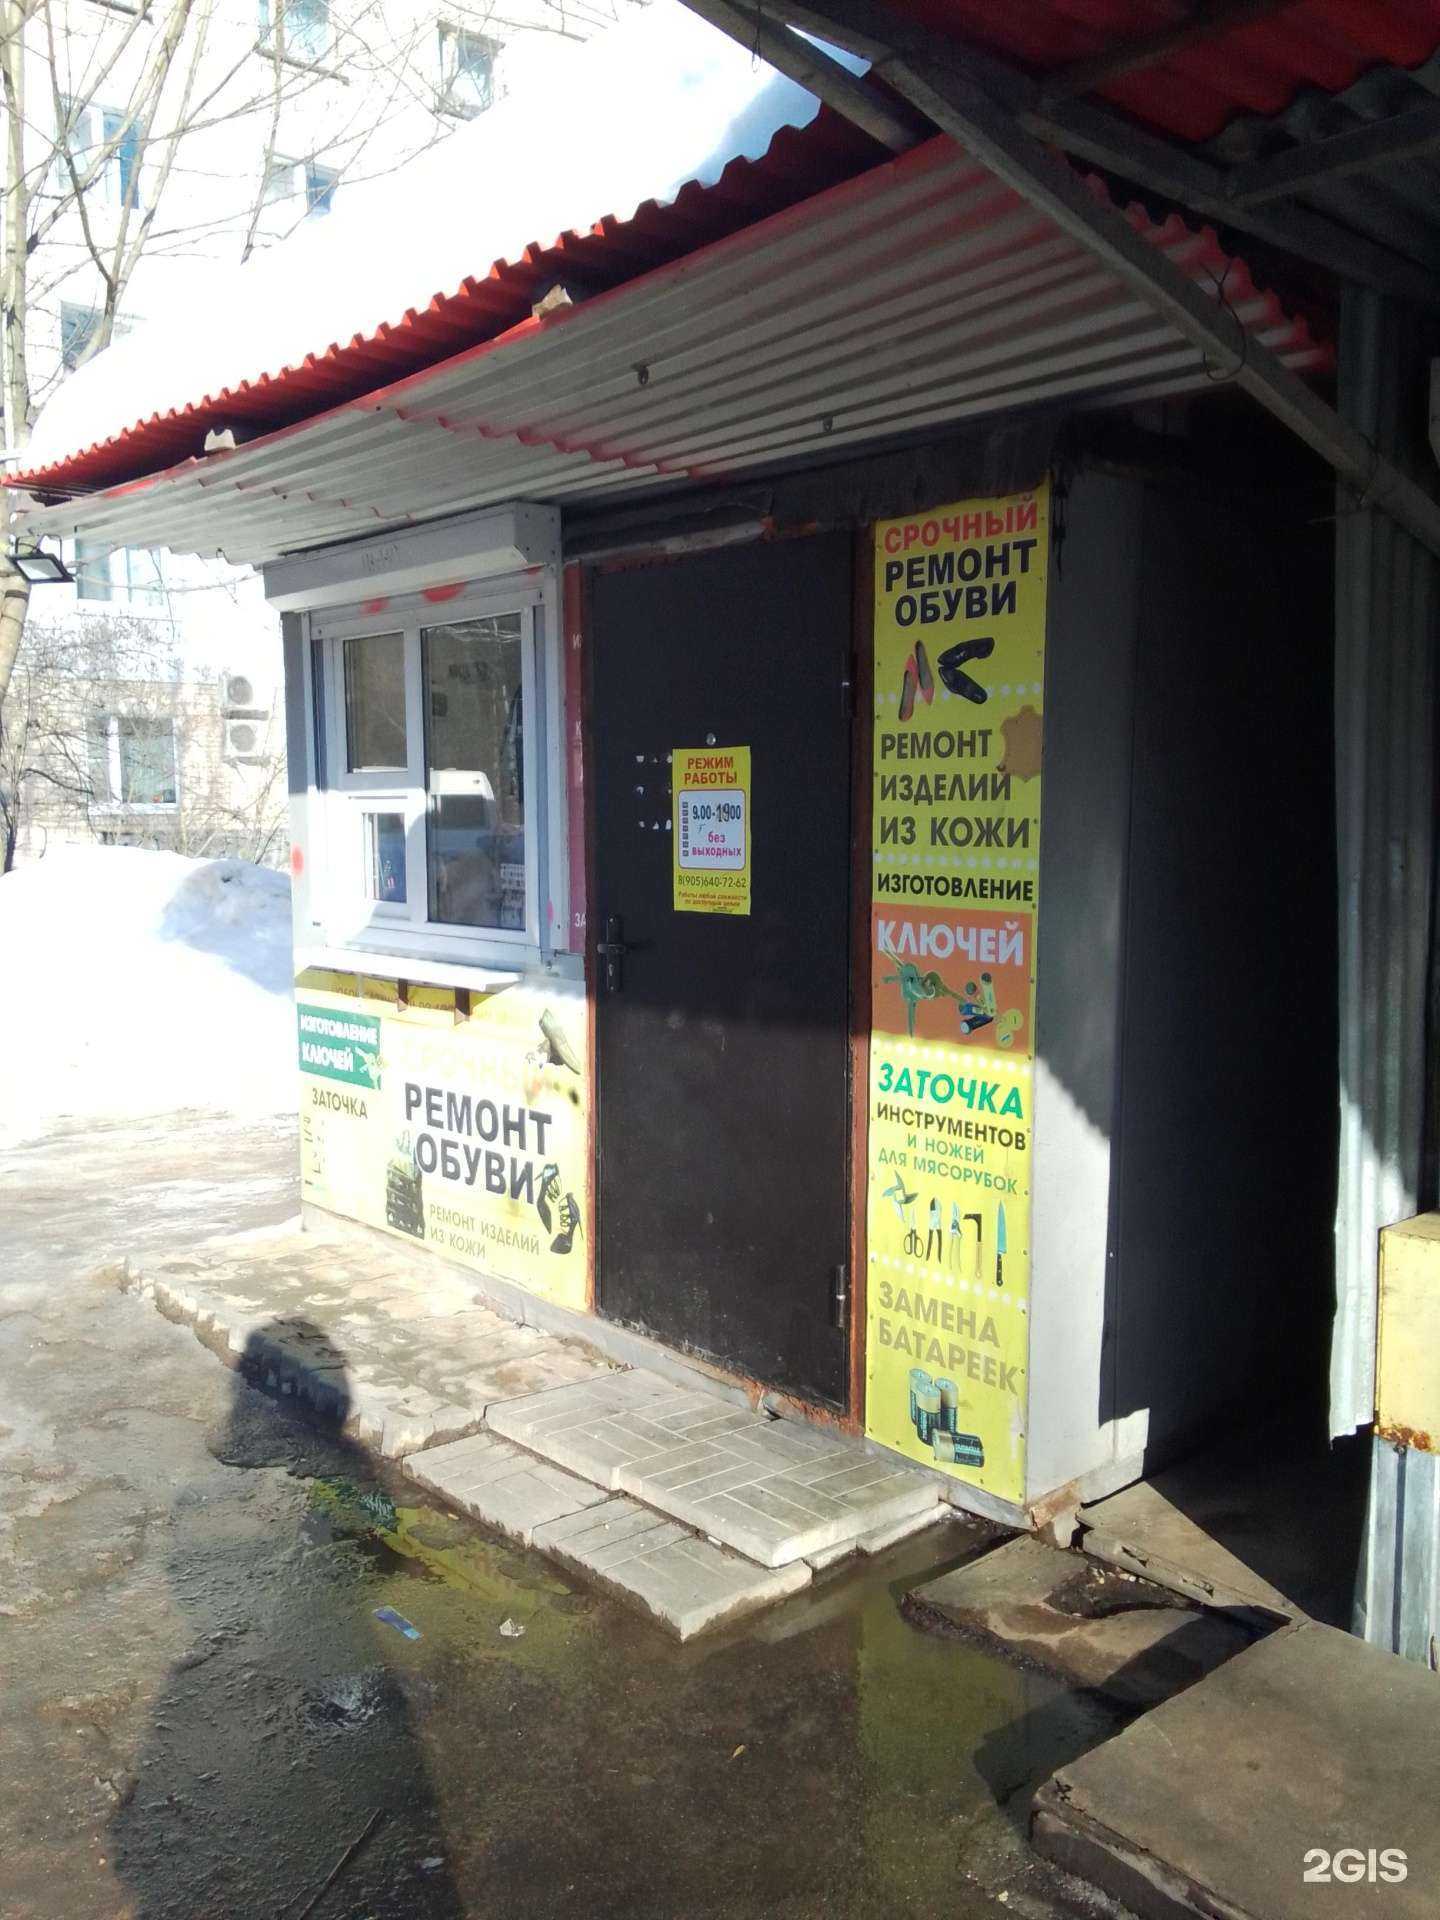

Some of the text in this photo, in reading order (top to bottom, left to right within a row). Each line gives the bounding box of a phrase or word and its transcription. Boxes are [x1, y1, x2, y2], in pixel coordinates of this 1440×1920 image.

[884, 495, 1038, 554] СРОЧНЫЙ
[885, 538, 1038, 592] РЕМОНТ
[895, 581, 1017, 627] ОБУВИ
[880, 729, 993, 760] РЕМОНТ
[684, 772, 737, 785] РАБОТЫ
[687, 757, 734, 770] РЕЖИМ
[880, 764, 1011, 806] ИЗДЕЛИЙ
[708, 831, 726, 844] без
[880, 816, 1030, 848] ИЗ КОЖИ
[692, 847, 742, 859] выходных
[678, 876, 746, 889] 8(905)640-72-62
[877, 872, 1034, 902] ИЗГОТОВЛЕНИЕ
[877, 919, 1024, 967] КЛЮЧЕЙ
[300, 1014, 378, 1046] ИЗГОТОВЛЕНИЕ
[302, 1042, 354, 1073] КЛЮЧЕЙ
[312, 1087, 369, 1120] ЗАТОЧКА
[878, 1062, 1024, 1120] ЗАТОЧКА
[404, 1082, 553, 1156] РЕМОНТ
[877, 1102, 1026, 1151] ИНСТРУМЕНТОВ
[907, 1132, 985, 1164] И НОЖЕЙ
[415, 1132, 536, 1205] ОБУВИ
[878, 1147, 1019, 1195] ДЛЯ МЯСОРУБОК
[429, 1204, 540, 1256] РЕМОНТ ИЗДЕЛИЙ
[430, 1226, 487, 1259] ИЗ КОЖИ
[878, 1281, 1001, 1348] ЗАМЕНА
[879, 1317, 1019, 1396] БАТАРЕЕК
